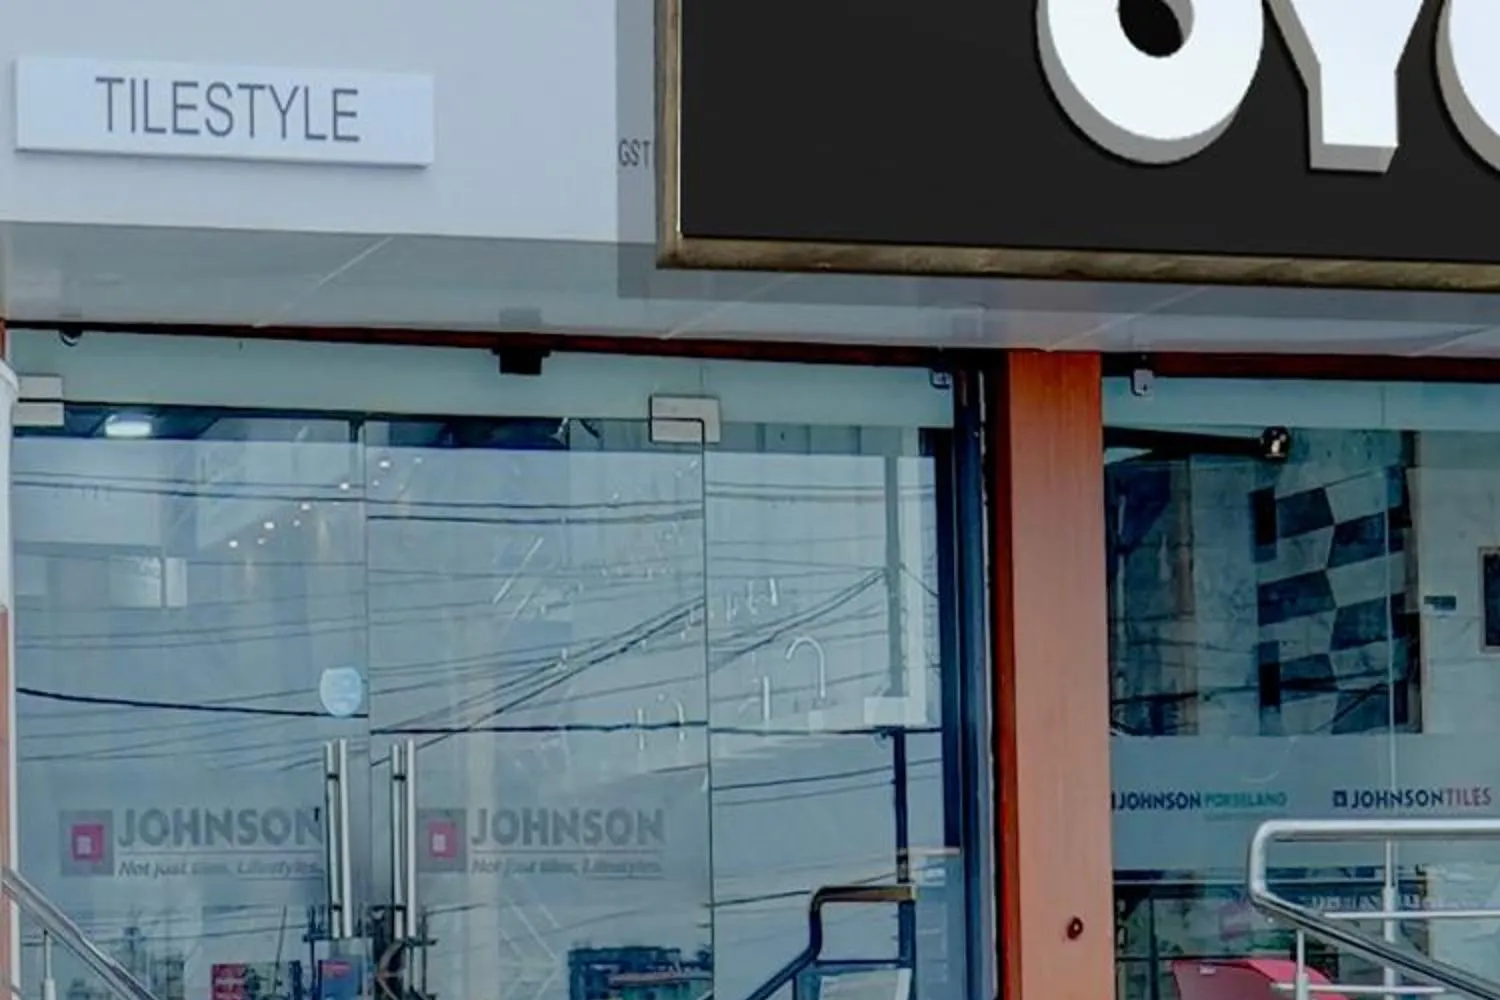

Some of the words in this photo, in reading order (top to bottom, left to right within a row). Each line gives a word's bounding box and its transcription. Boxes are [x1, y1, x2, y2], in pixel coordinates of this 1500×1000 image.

[95, 76, 361, 143] TILESTYLE
[617, 138, 651, 169] GST
[117, 808, 324, 847] JOHNSON
[470, 808, 665, 847] JOHNSON
